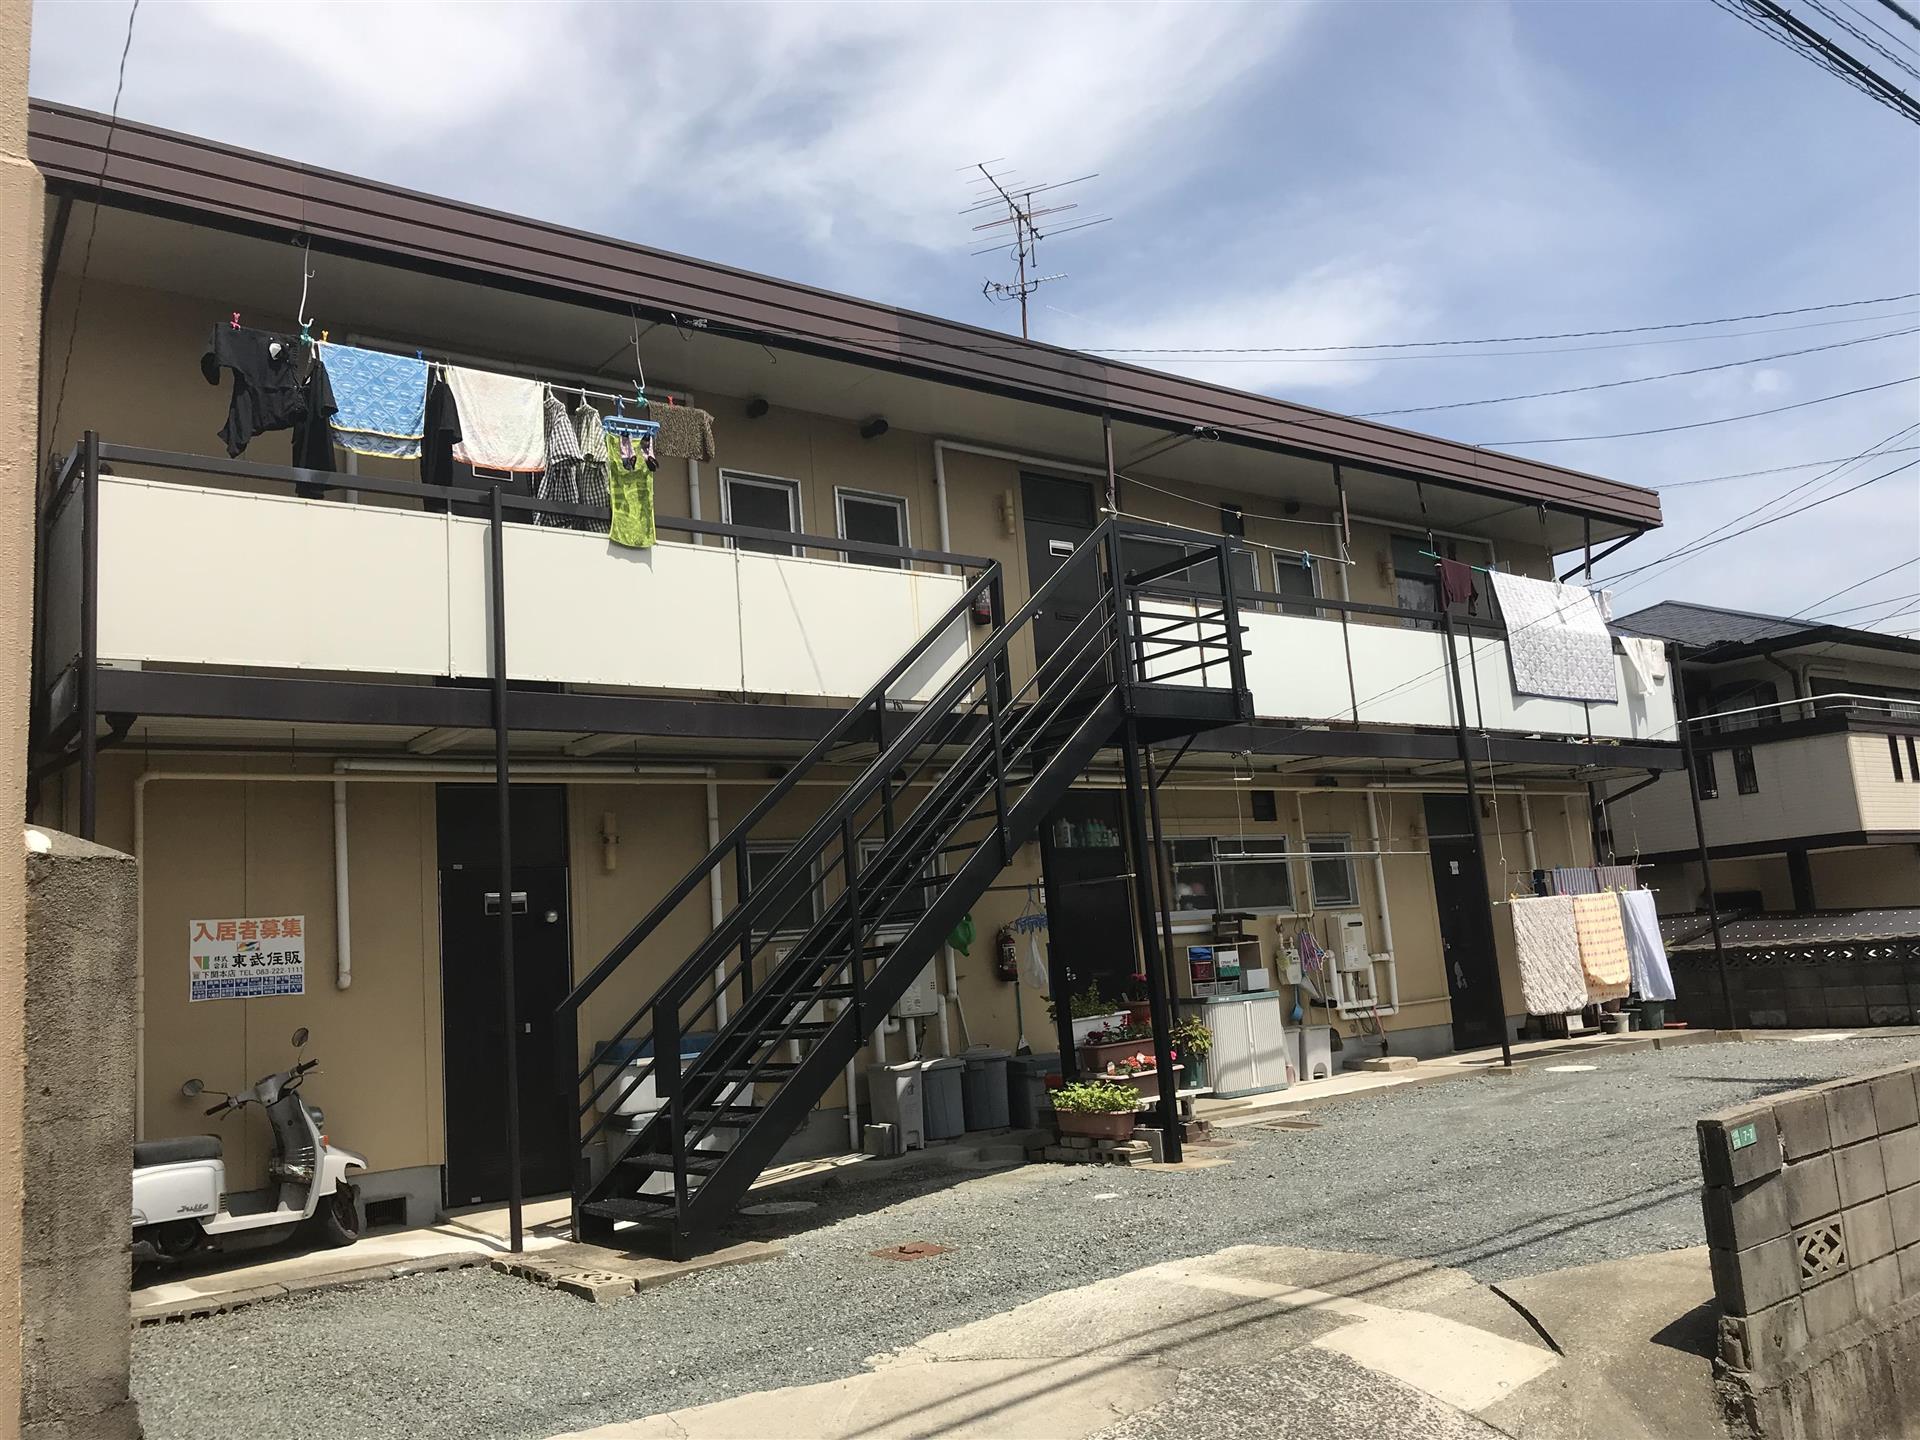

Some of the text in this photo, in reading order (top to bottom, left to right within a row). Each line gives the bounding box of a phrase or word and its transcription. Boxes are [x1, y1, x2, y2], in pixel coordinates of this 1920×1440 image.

[193, 918, 302, 942] 入居者募集
[232, 951, 302, 968] 東武住販
[202, 970, 236, 979] 下関本店
